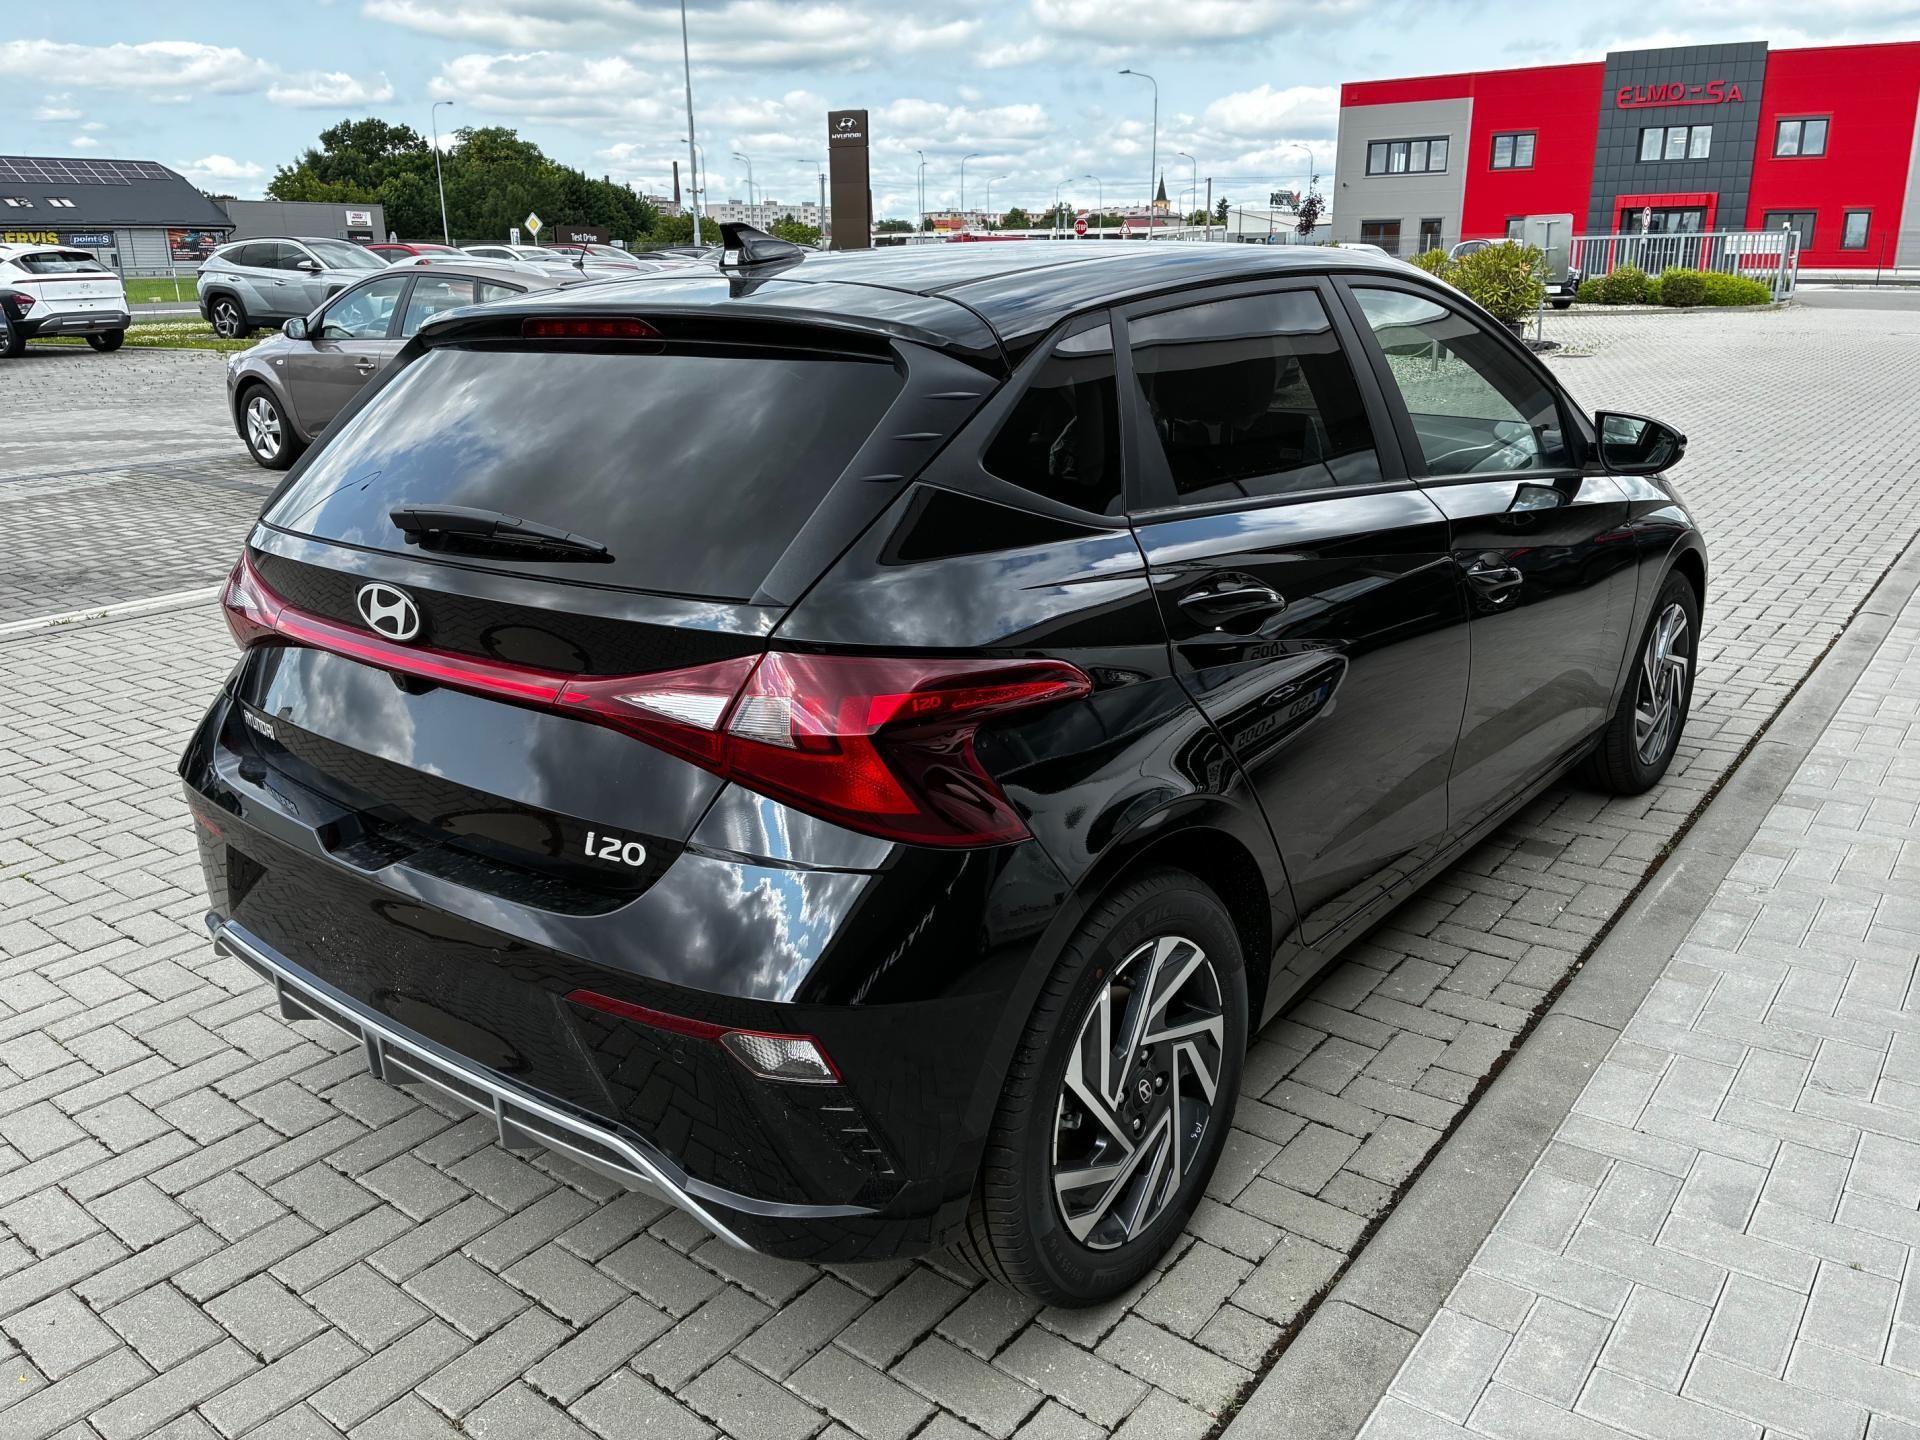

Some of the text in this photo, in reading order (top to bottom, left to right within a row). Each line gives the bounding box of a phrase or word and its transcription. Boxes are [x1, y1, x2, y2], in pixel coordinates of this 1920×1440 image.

[570, 232, 598, 242] Test Drive
[1075, 223, 1086, 231] STOP
[243, 709, 276, 740] HYUNDAI
[584, 831, 647, 867] i20
